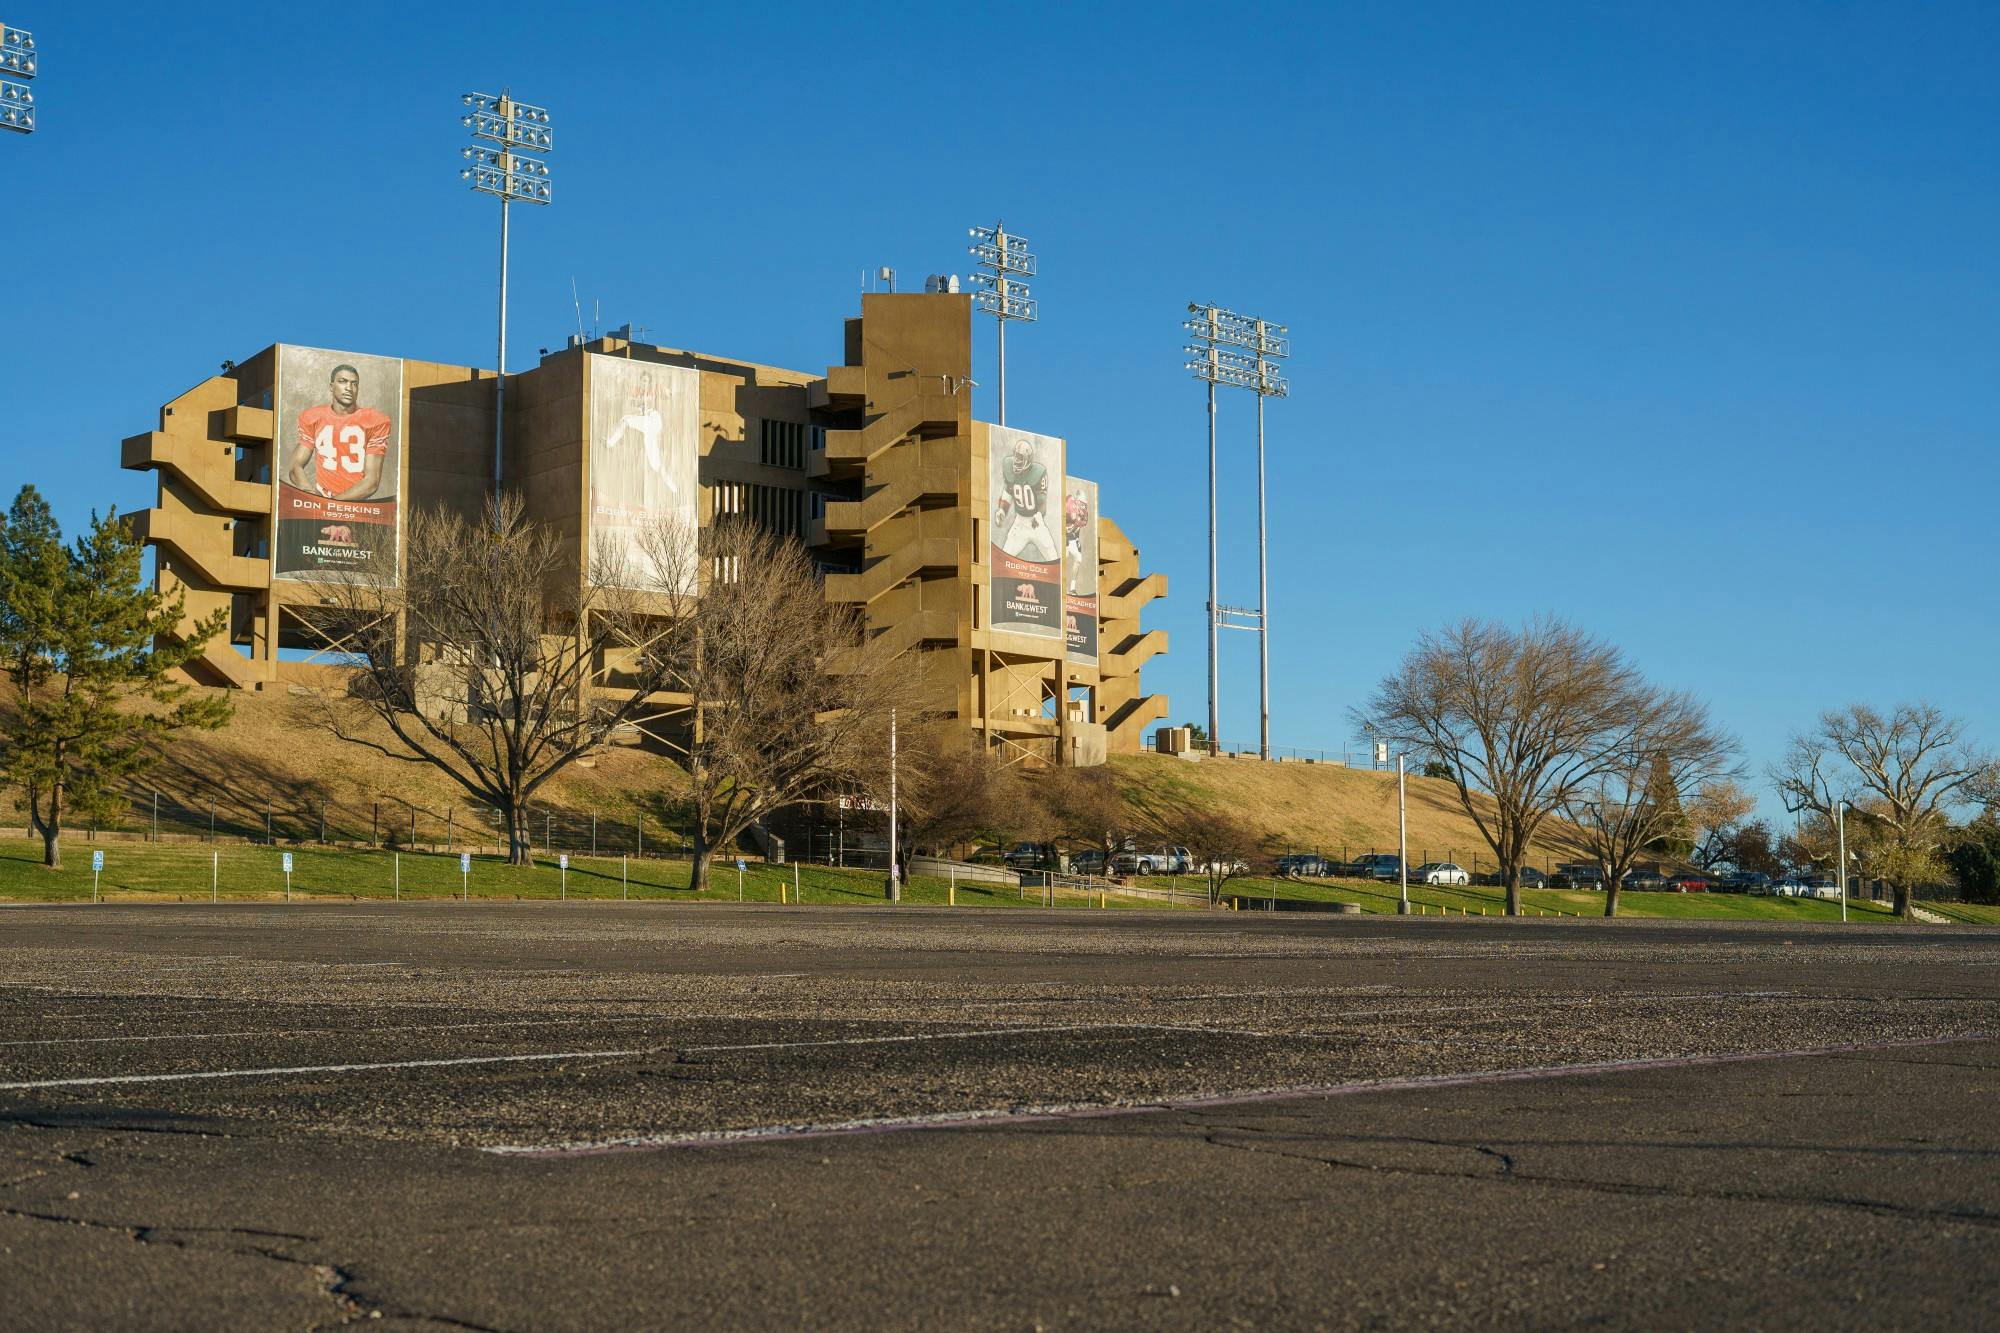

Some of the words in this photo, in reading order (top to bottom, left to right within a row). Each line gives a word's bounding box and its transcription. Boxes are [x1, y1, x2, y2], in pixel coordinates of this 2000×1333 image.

[315, 424, 365, 473] 43
[1013, 484, 1036, 510] 90
[293, 499, 321, 509] DON
[328, 502, 381, 515] PERKINS
[303, 545, 333, 557] BANK
[342, 548, 374, 560] WEST
[1005, 561, 1028, 570] ROBIN
[1006, 600, 1023, 611] BANK
[1030, 604, 1048, 615] WEST
[1072, 635, 1087, 643] WEST
